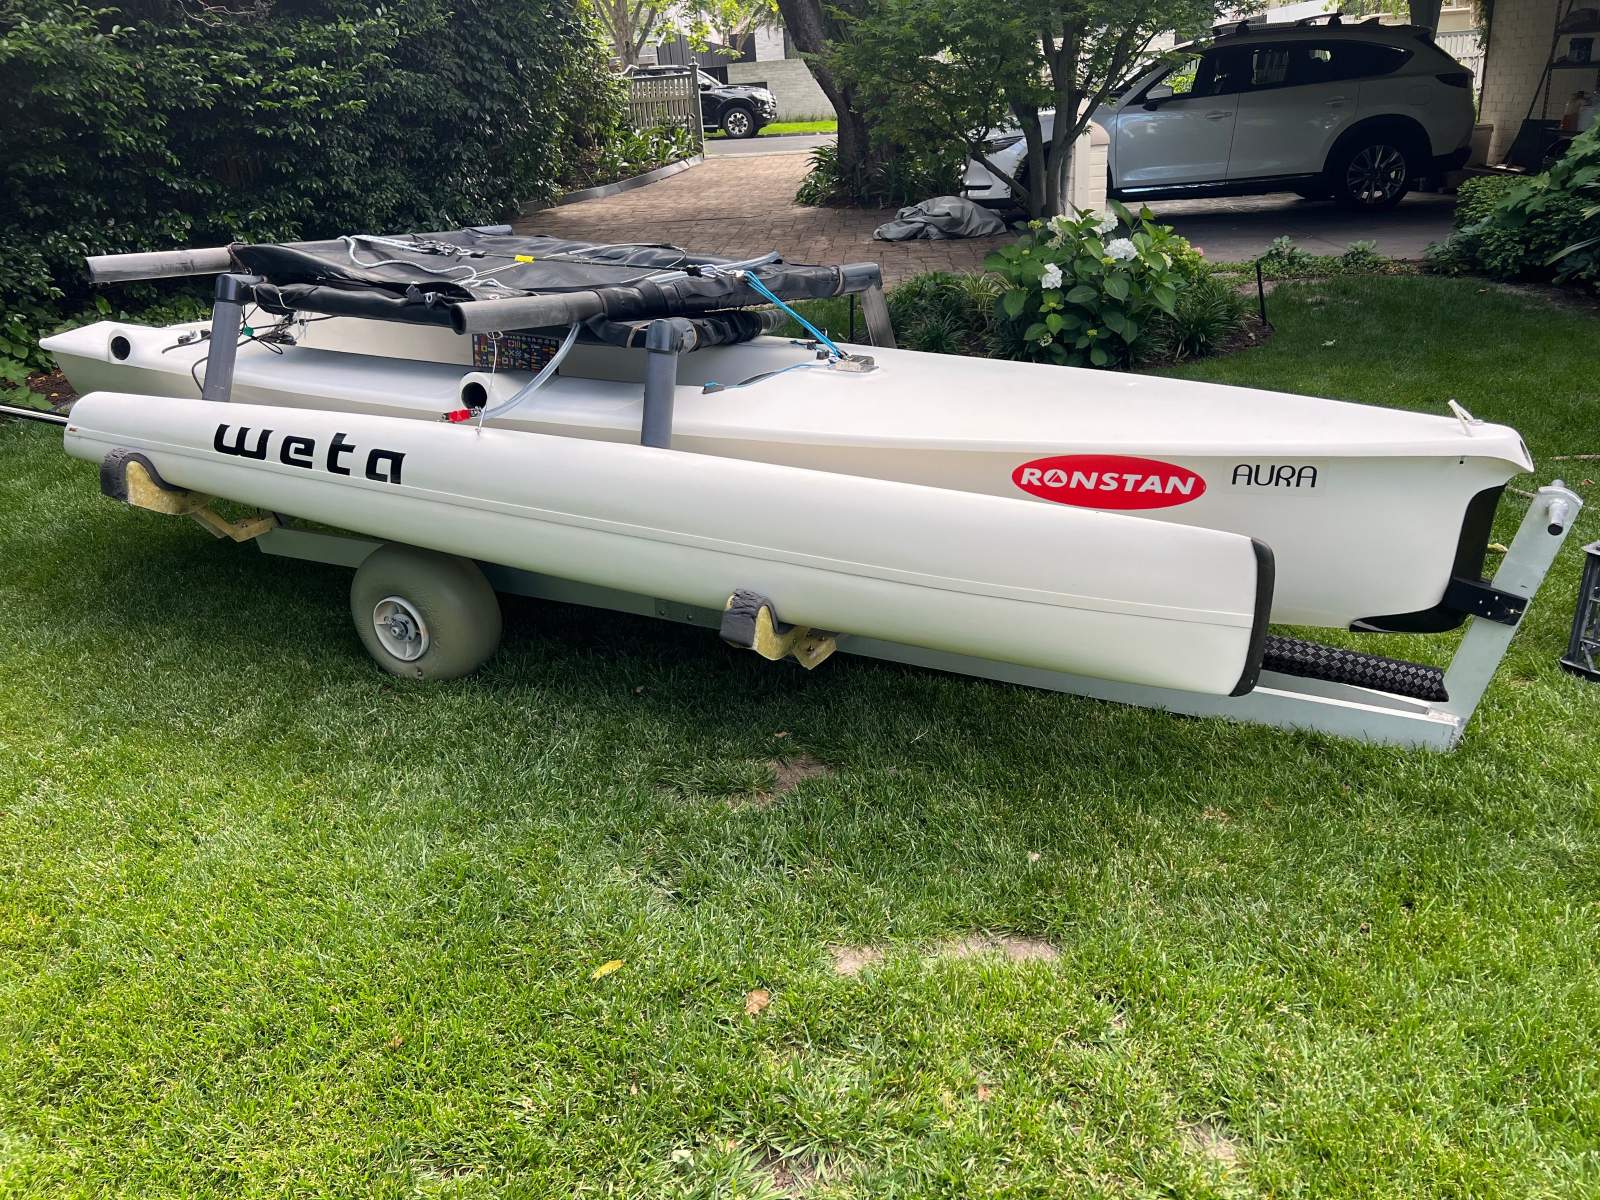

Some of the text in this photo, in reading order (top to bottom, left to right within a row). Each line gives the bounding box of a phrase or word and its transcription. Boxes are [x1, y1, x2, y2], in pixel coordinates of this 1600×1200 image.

[214, 423, 406, 485] weta
[1020, 467, 1196, 496] RONSTAN
[1231, 464, 1318, 488] AURA
